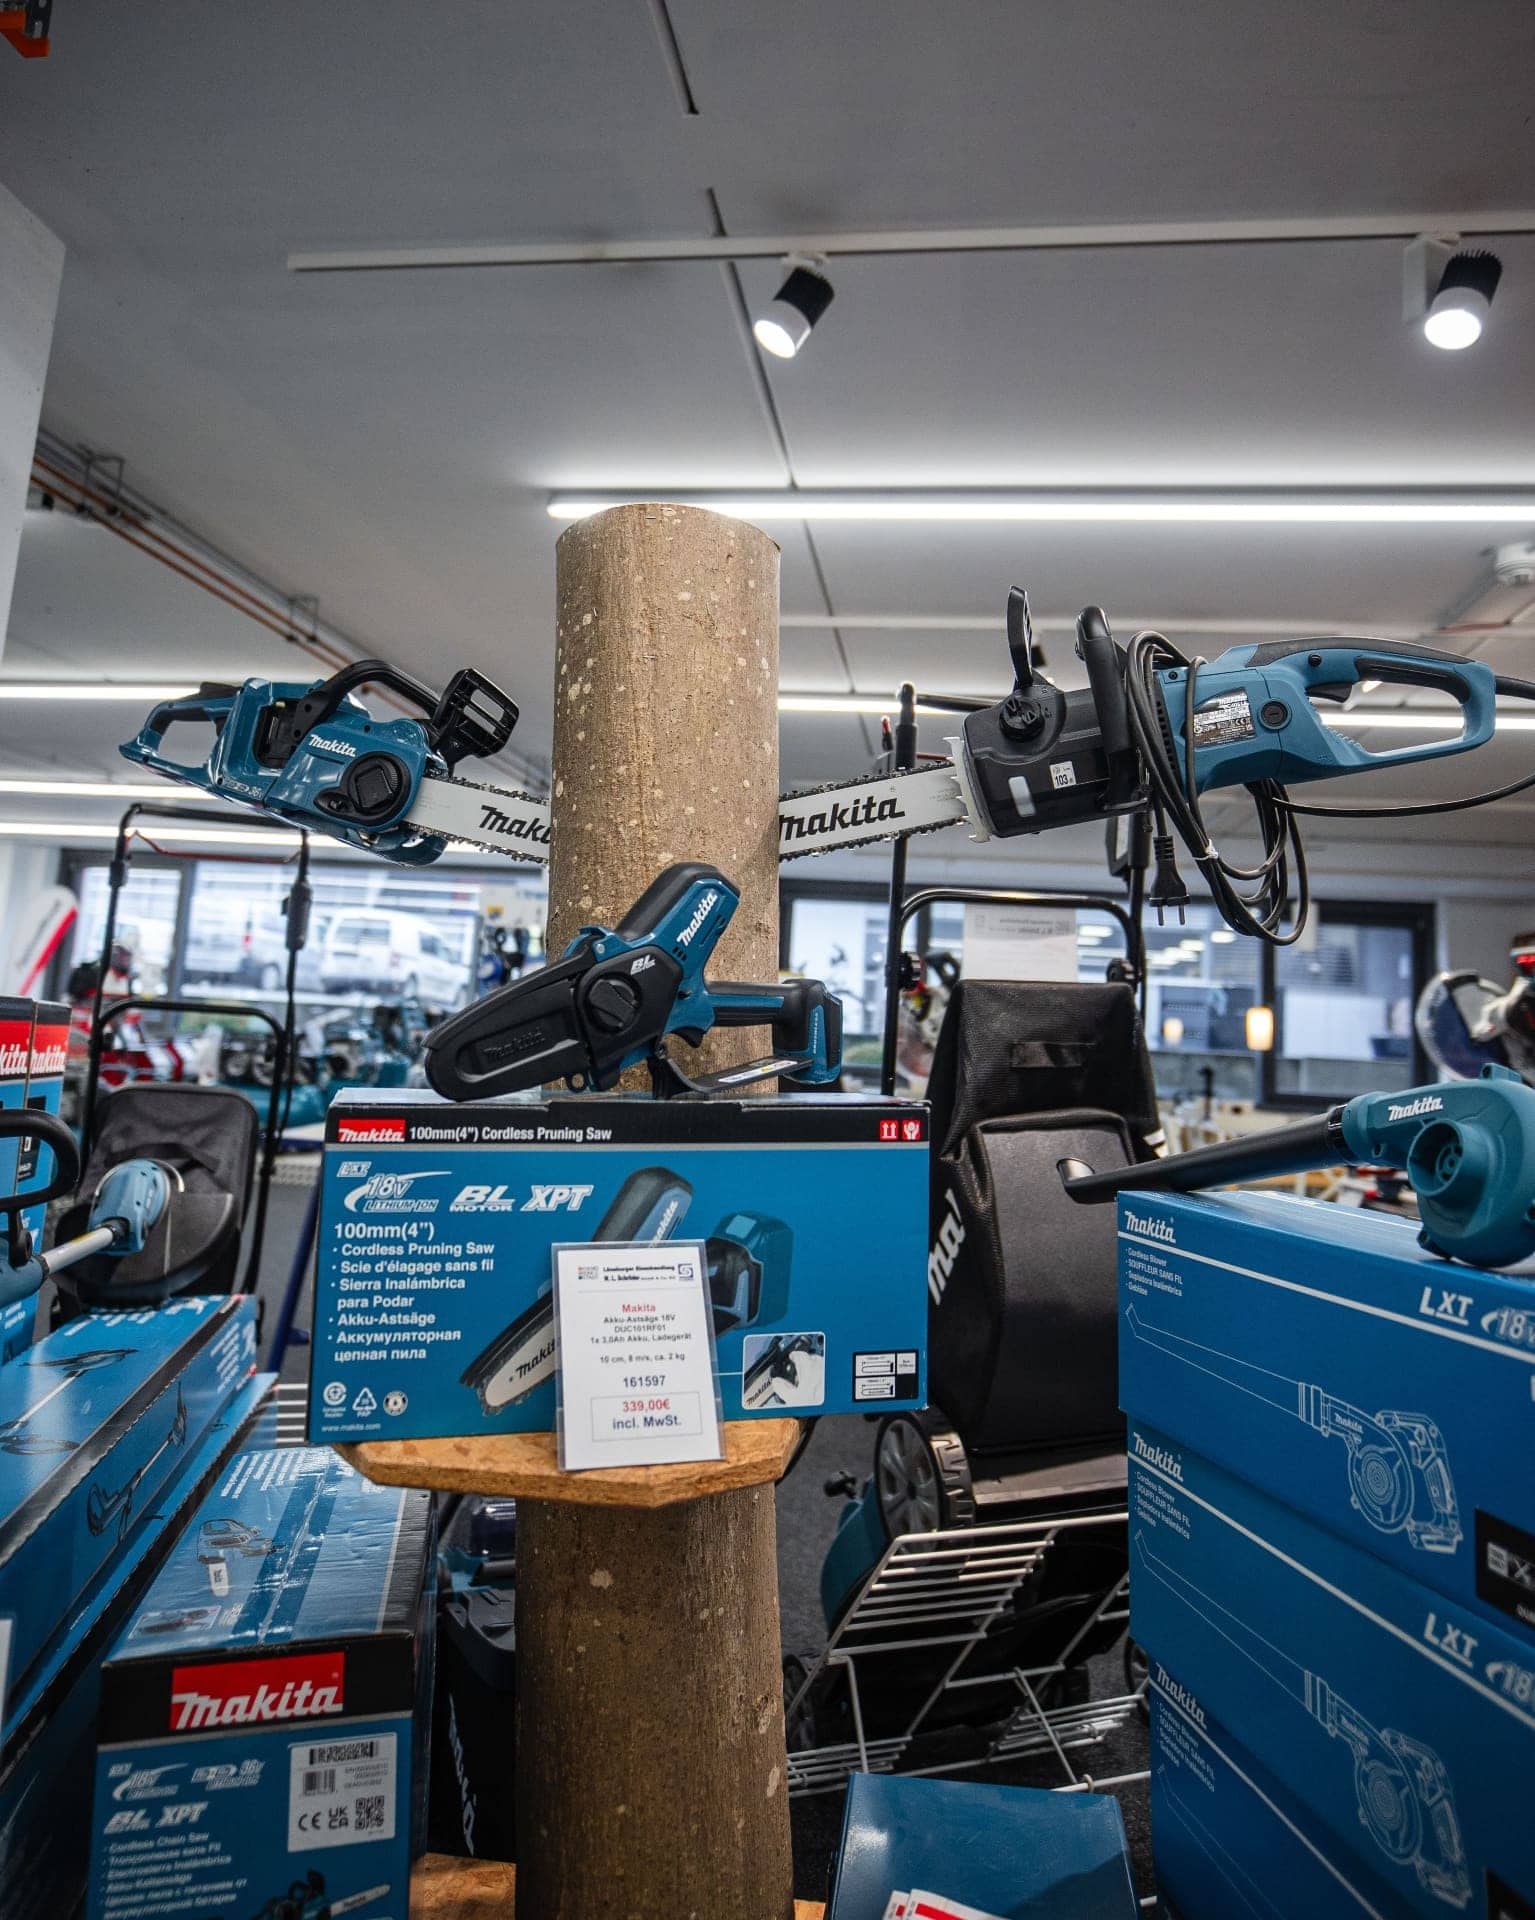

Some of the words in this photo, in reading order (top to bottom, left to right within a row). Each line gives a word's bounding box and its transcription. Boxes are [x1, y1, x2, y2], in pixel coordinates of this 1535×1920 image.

[1055, 774, 1068, 786] 103
[410, 1126, 478, 1142] 100mm(4")
[482, 1126, 534, 1140] Cordless
[536, 1127, 583, 1142] Pruning
[586, 1128, 612, 1140] Saw
[451, 1184, 516, 1203] BL
[520, 1184, 594, 1212] XPT
[450, 1204, 512, 1212] MOTOR
[334, 1222, 435, 1241] 100mm(4")
[341, 1243, 404, 1256] Cordless
[408, 1243, 462, 1257] Pruning
[466, 1242, 495, 1254] Saw
[1128, 1247, 1150, 1260] Cordless
[1150, 1254, 1167, 1266] Blower
[340, 1261, 372, 1274] Scie
[375, 1260, 442, 1275] d'élagage
[445, 1261, 478, 1272] sans
[481, 1259, 494, 1272] fil
[1128, 1259, 1158, 1275] SOUFFLEUR
[1158, 1269, 1174, 1282] SANS
[1174, 1274, 1183, 1284] FIL
[340, 1278, 382, 1292] Sierra
[386, 1277, 466, 1290] Inalámbrica
[337, 1298, 369, 1310] para
[373, 1295, 415, 1308] Podar
[622, 1304, 656, 1313] Makita
[1420, 1286, 1474, 1318] LXT
[337, 1312, 436, 1327] Akku-Astsäge
[336, 1330, 462, 1345] Аккумуляторная
[652, 1331, 692, 1343] Ladegerät
[334, 1351, 387, 1362] цепная
[391, 1348, 426, 1359] пила
[600, 1356, 610, 1364] 10
[675, 1352, 686, 1361] kg
[623, 1376, 666, 1388] 161597
[622, 1398, 671, 1413] 339,00€
[322, 1424, 381, 1432] www.makita.com
[612, 1418, 640, 1430] incl.
[643, 1416, 682, 1427] MwSt.
[1424, 1612, 1478, 1658] LXT
[328, 1806, 348, 1818] UK
[298, 1812, 322, 1831] CE
